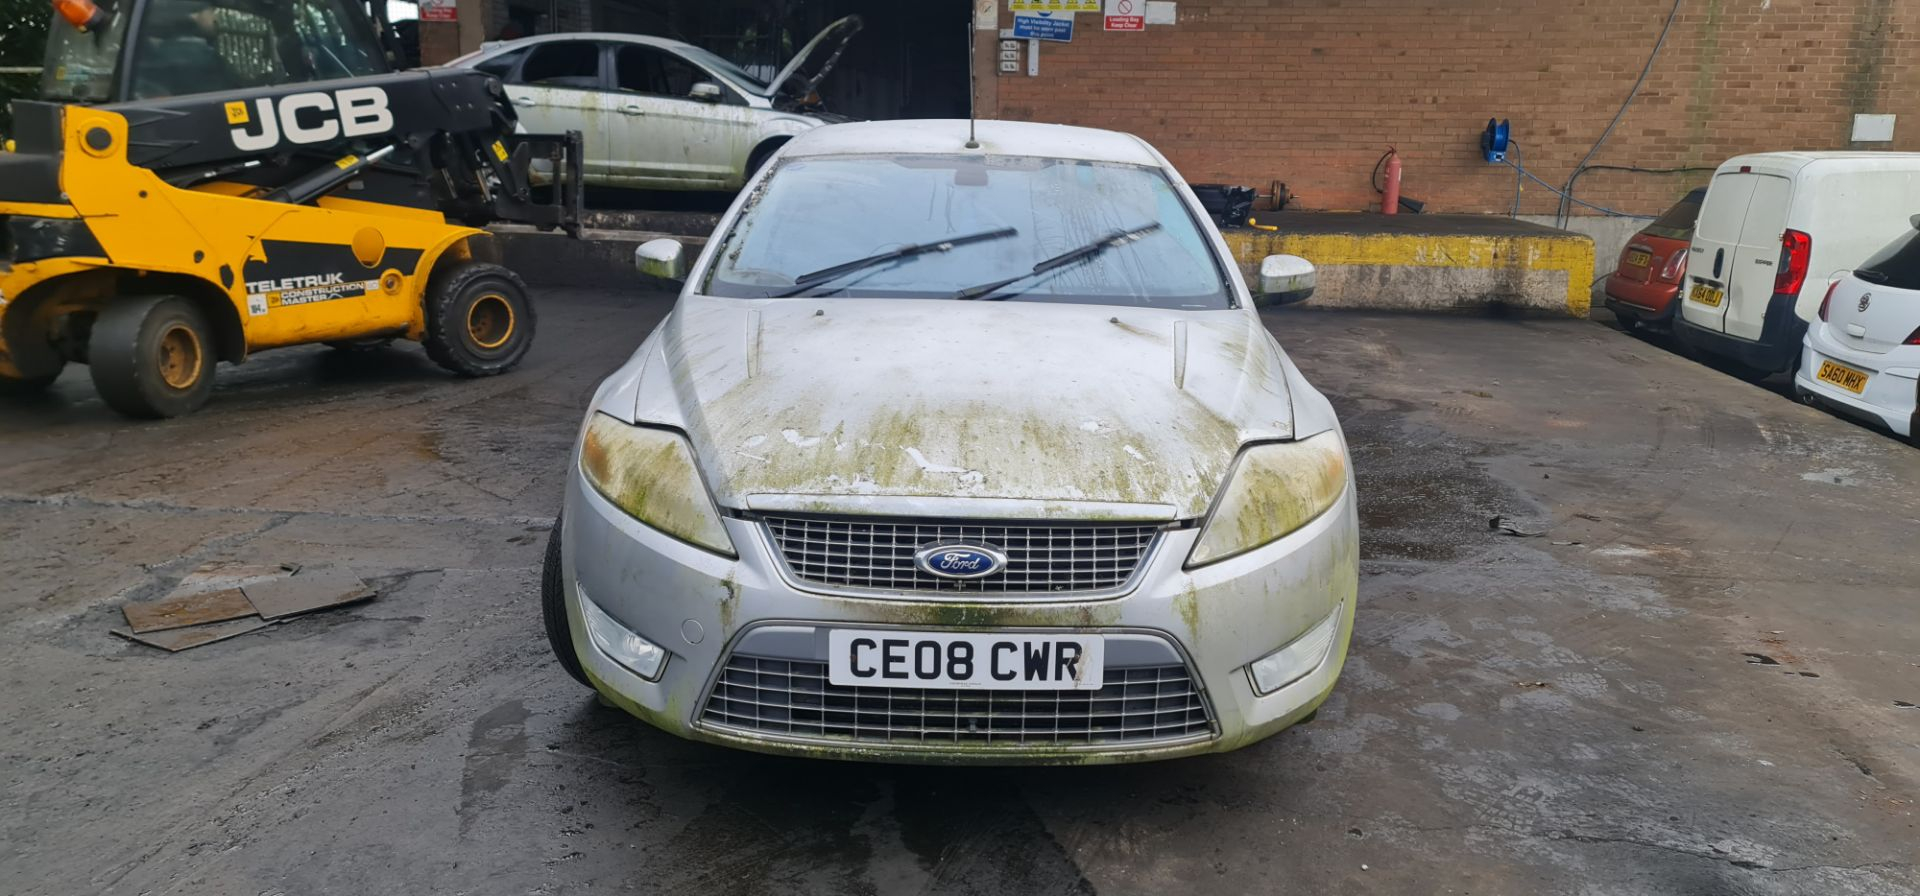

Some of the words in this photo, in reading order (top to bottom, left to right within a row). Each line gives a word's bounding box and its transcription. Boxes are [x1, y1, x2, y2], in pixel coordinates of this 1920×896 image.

[230, 86, 394, 151] JCB
[245, 272, 344, 293] TELETRUK
[281, 281, 364, 299] CONSTRUCTION
[281, 294, 329, 306] MASTER
[1821, 363, 1846, 383] SA60
[1843, 370, 1866, 390] MHX
[940, 552, 980, 570] Ford
[850, 637, 975, 681] CE08
[989, 641, 1084, 682] CWR
